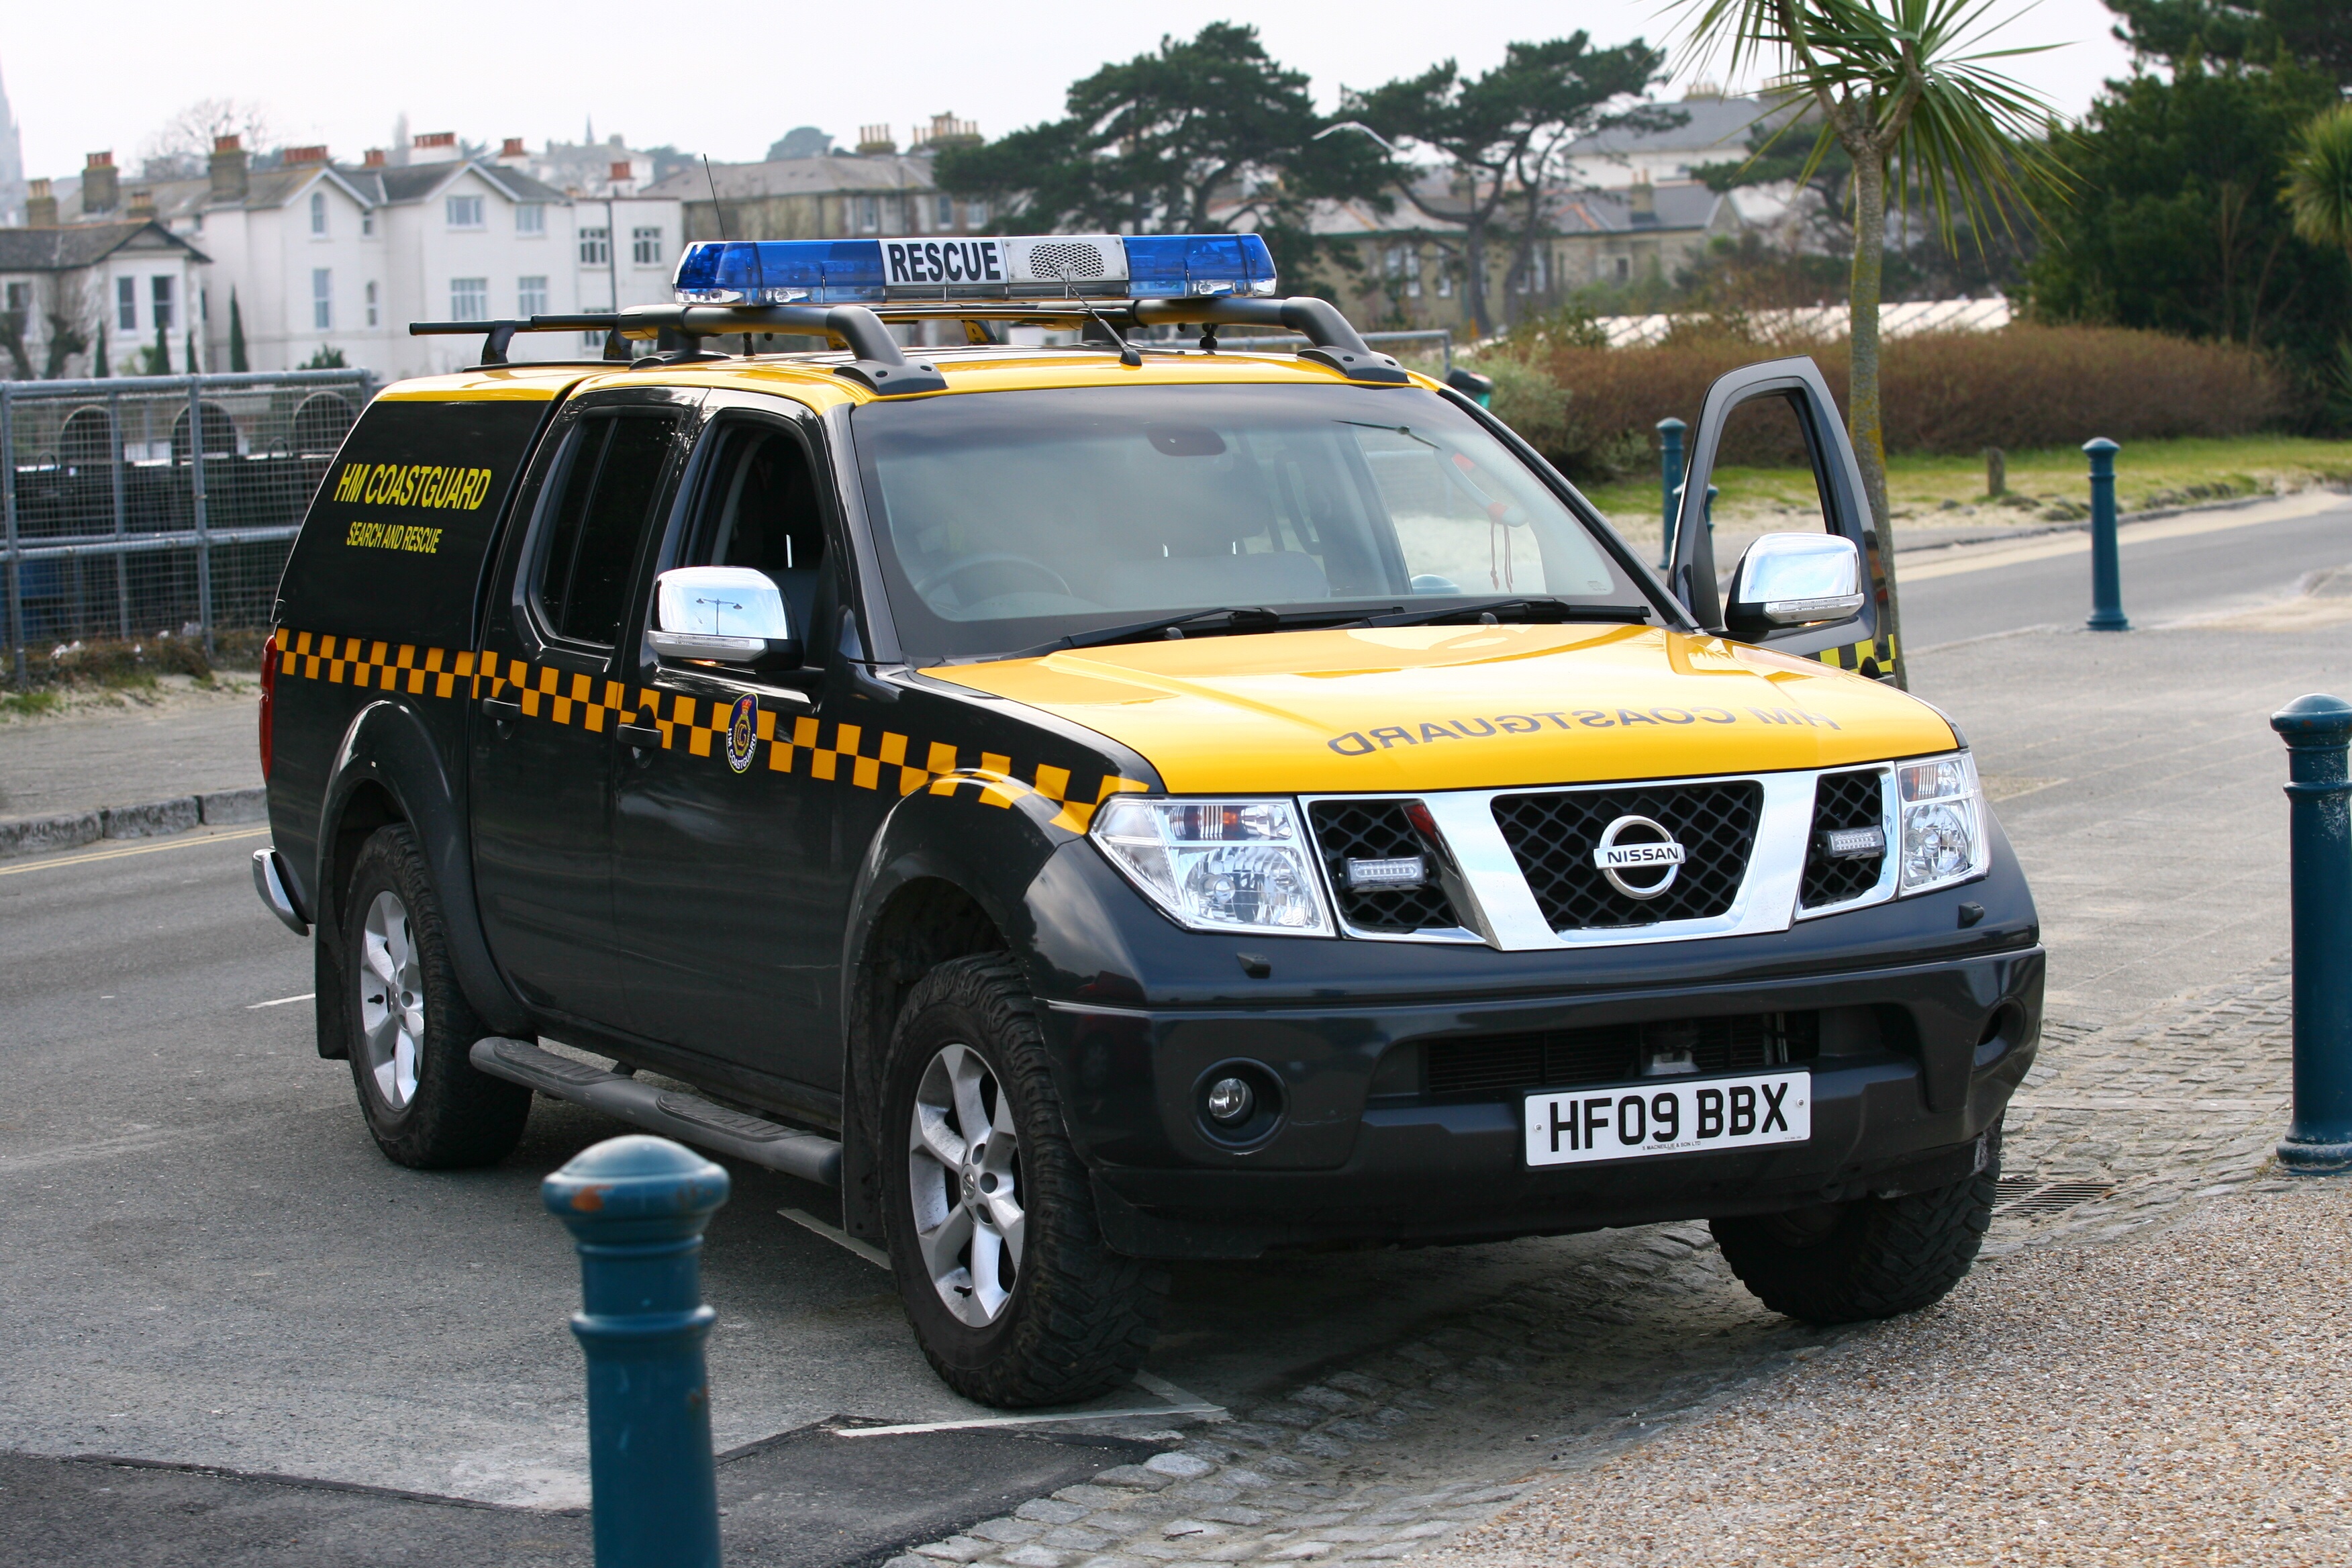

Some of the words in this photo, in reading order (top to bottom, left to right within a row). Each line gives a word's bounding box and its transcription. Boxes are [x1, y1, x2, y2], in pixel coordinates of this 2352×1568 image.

[887, 242, 1001, 282] RESCUE
[334, 463, 371, 502] HM
[364, 464, 492, 510] COASTGUARD
[346, 521, 386, 548] SEARCH
[381, 524, 405, 550] AND
[401, 526, 443, 554] RESCUE
[728, 733, 757, 770] COASTGUARD
[1607, 846, 1679, 864] NISSAN
[1549, 1091, 1679, 1153] HF09
[1696, 1082, 1789, 1139] BBX
